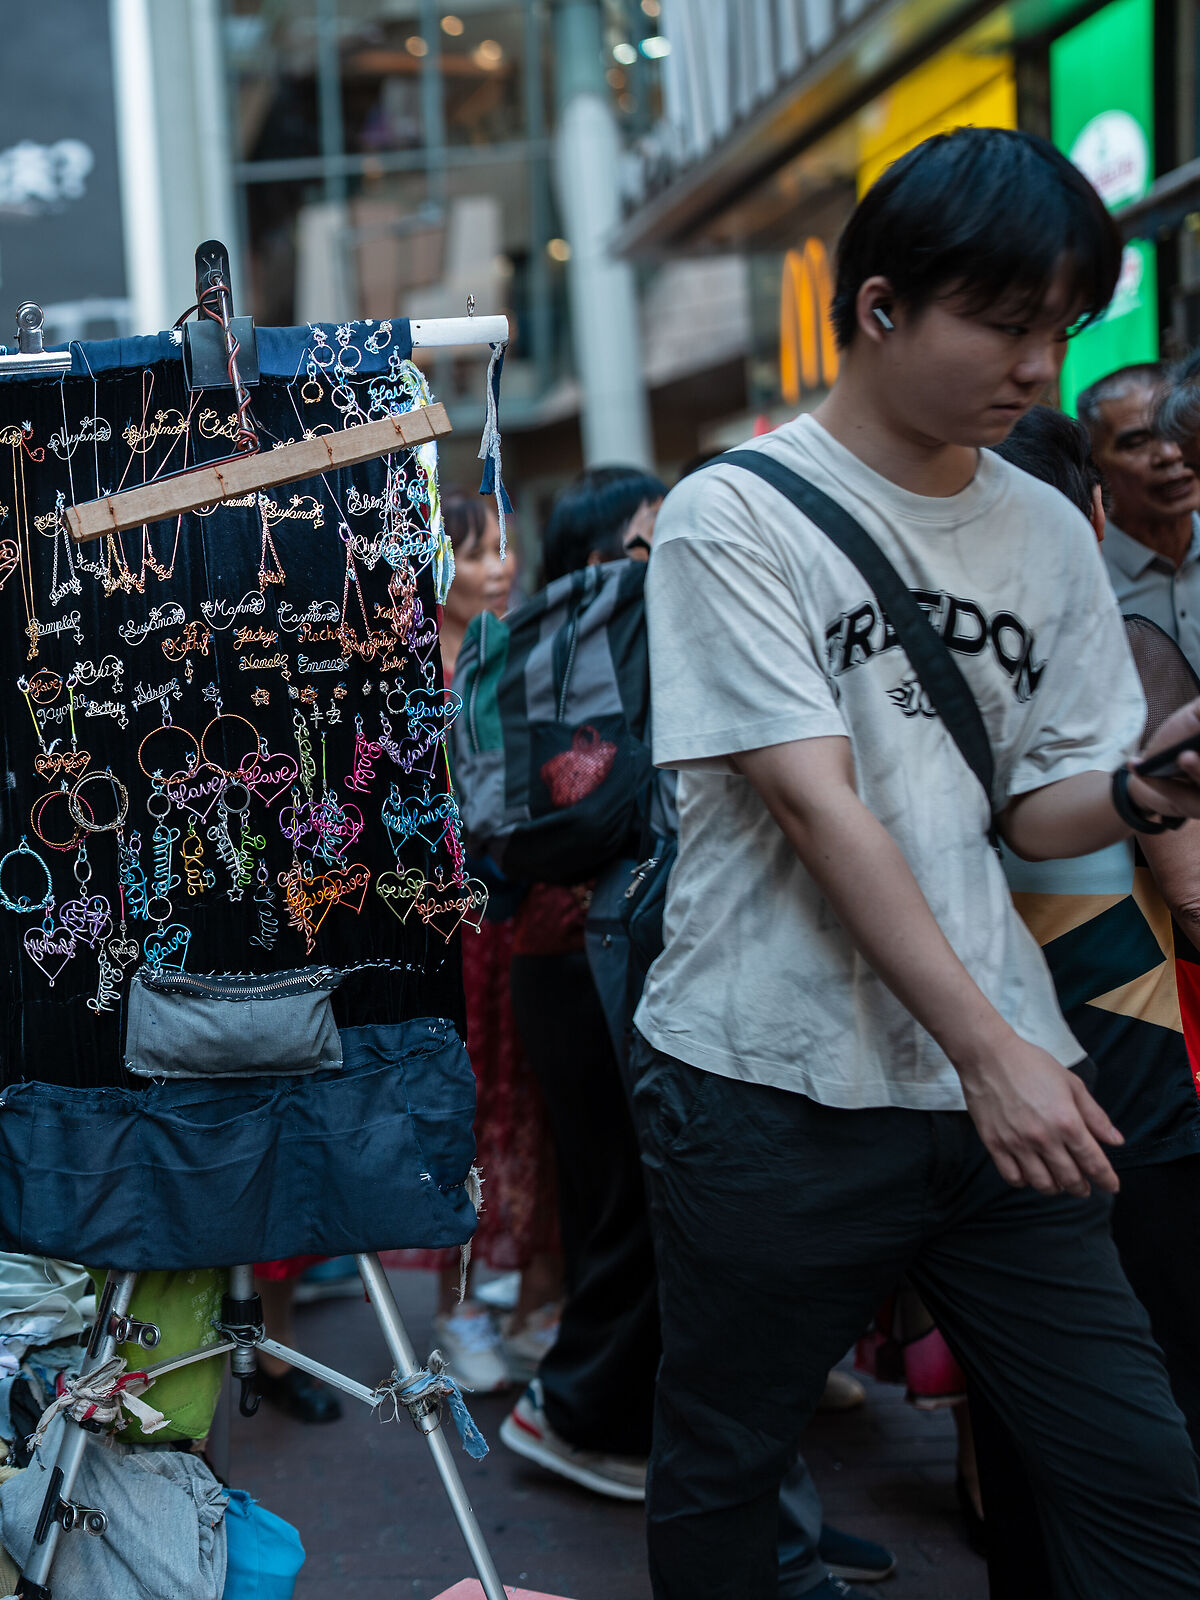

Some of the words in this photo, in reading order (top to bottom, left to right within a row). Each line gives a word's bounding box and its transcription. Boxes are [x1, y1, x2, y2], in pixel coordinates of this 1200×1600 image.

[406, 701, 462, 726] Love
[243, 766, 298, 790] Love
[168, 776, 227, 810] Love
[288, 886, 338, 917] Love
[414, 897, 473, 924] Love
[146, 929, 192, 970] Love
